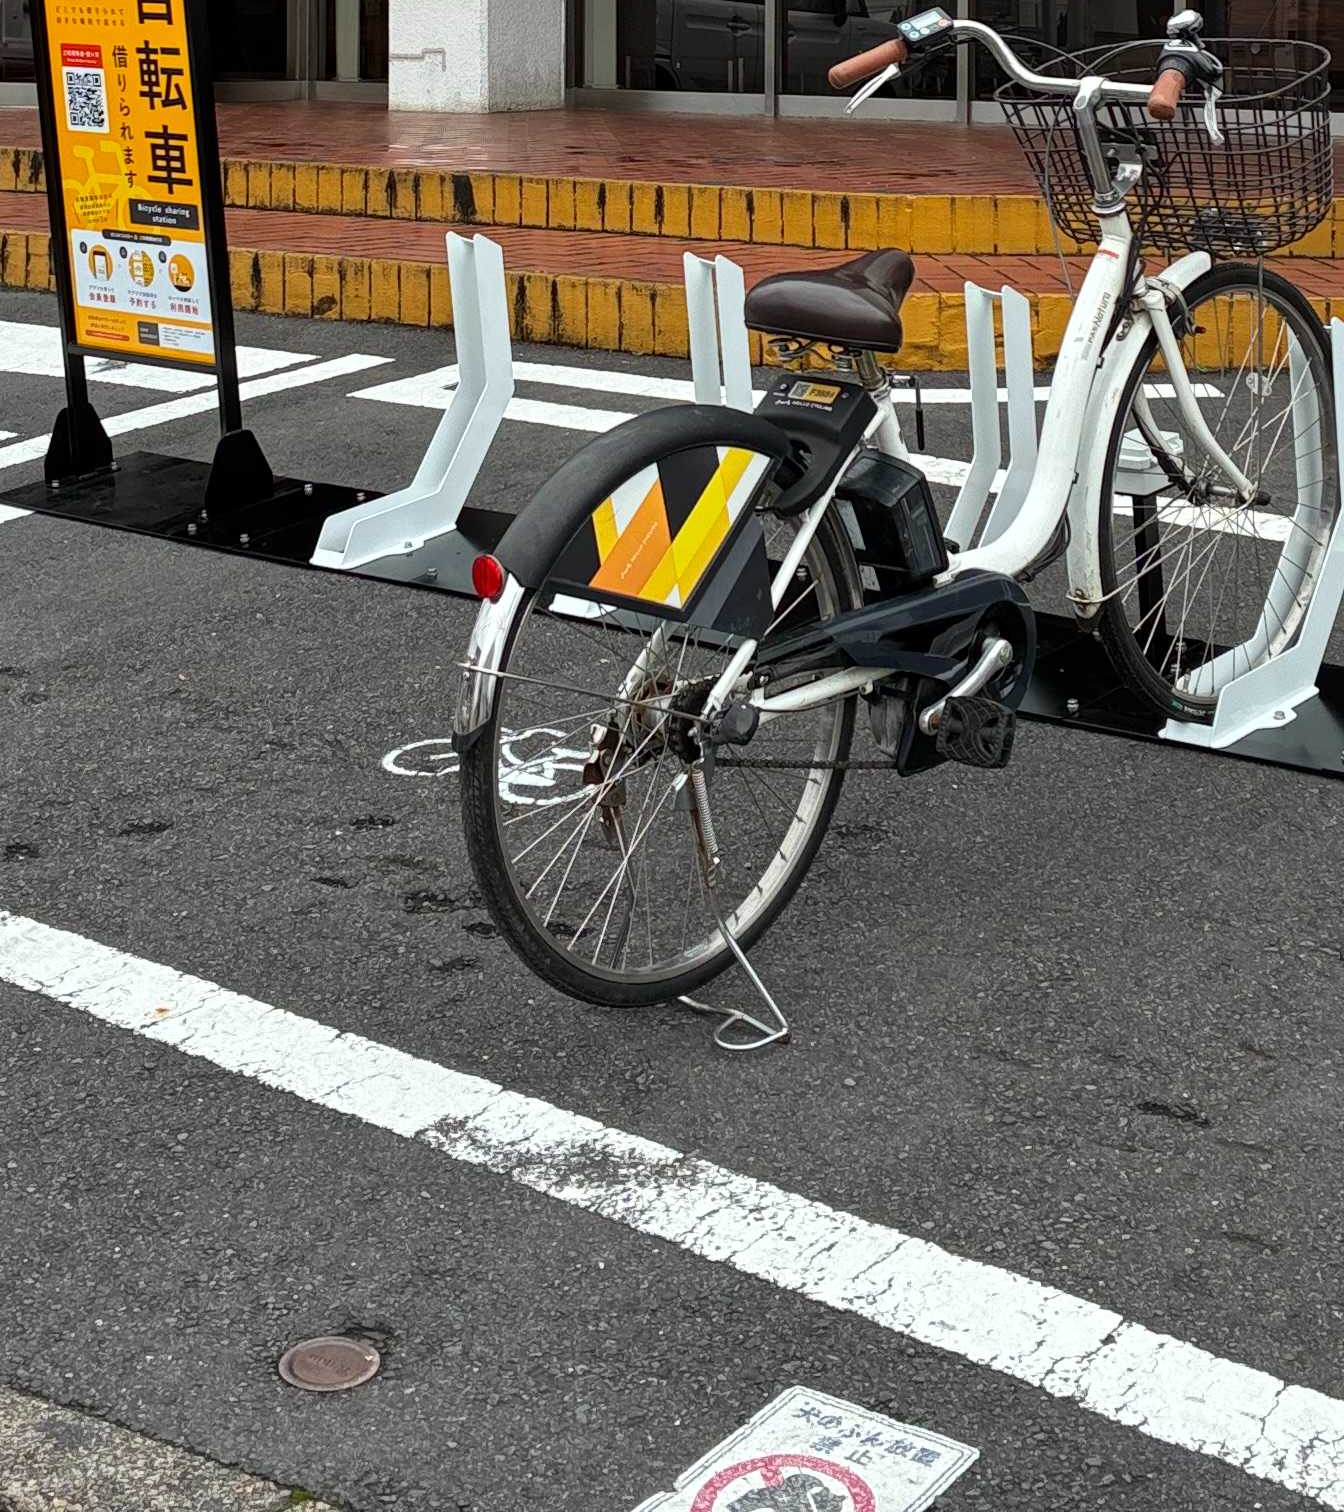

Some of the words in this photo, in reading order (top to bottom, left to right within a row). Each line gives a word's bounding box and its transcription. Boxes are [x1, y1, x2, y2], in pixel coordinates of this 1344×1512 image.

[112, 45, 137, 188] 借りられます
[152, 216, 176, 224] station
